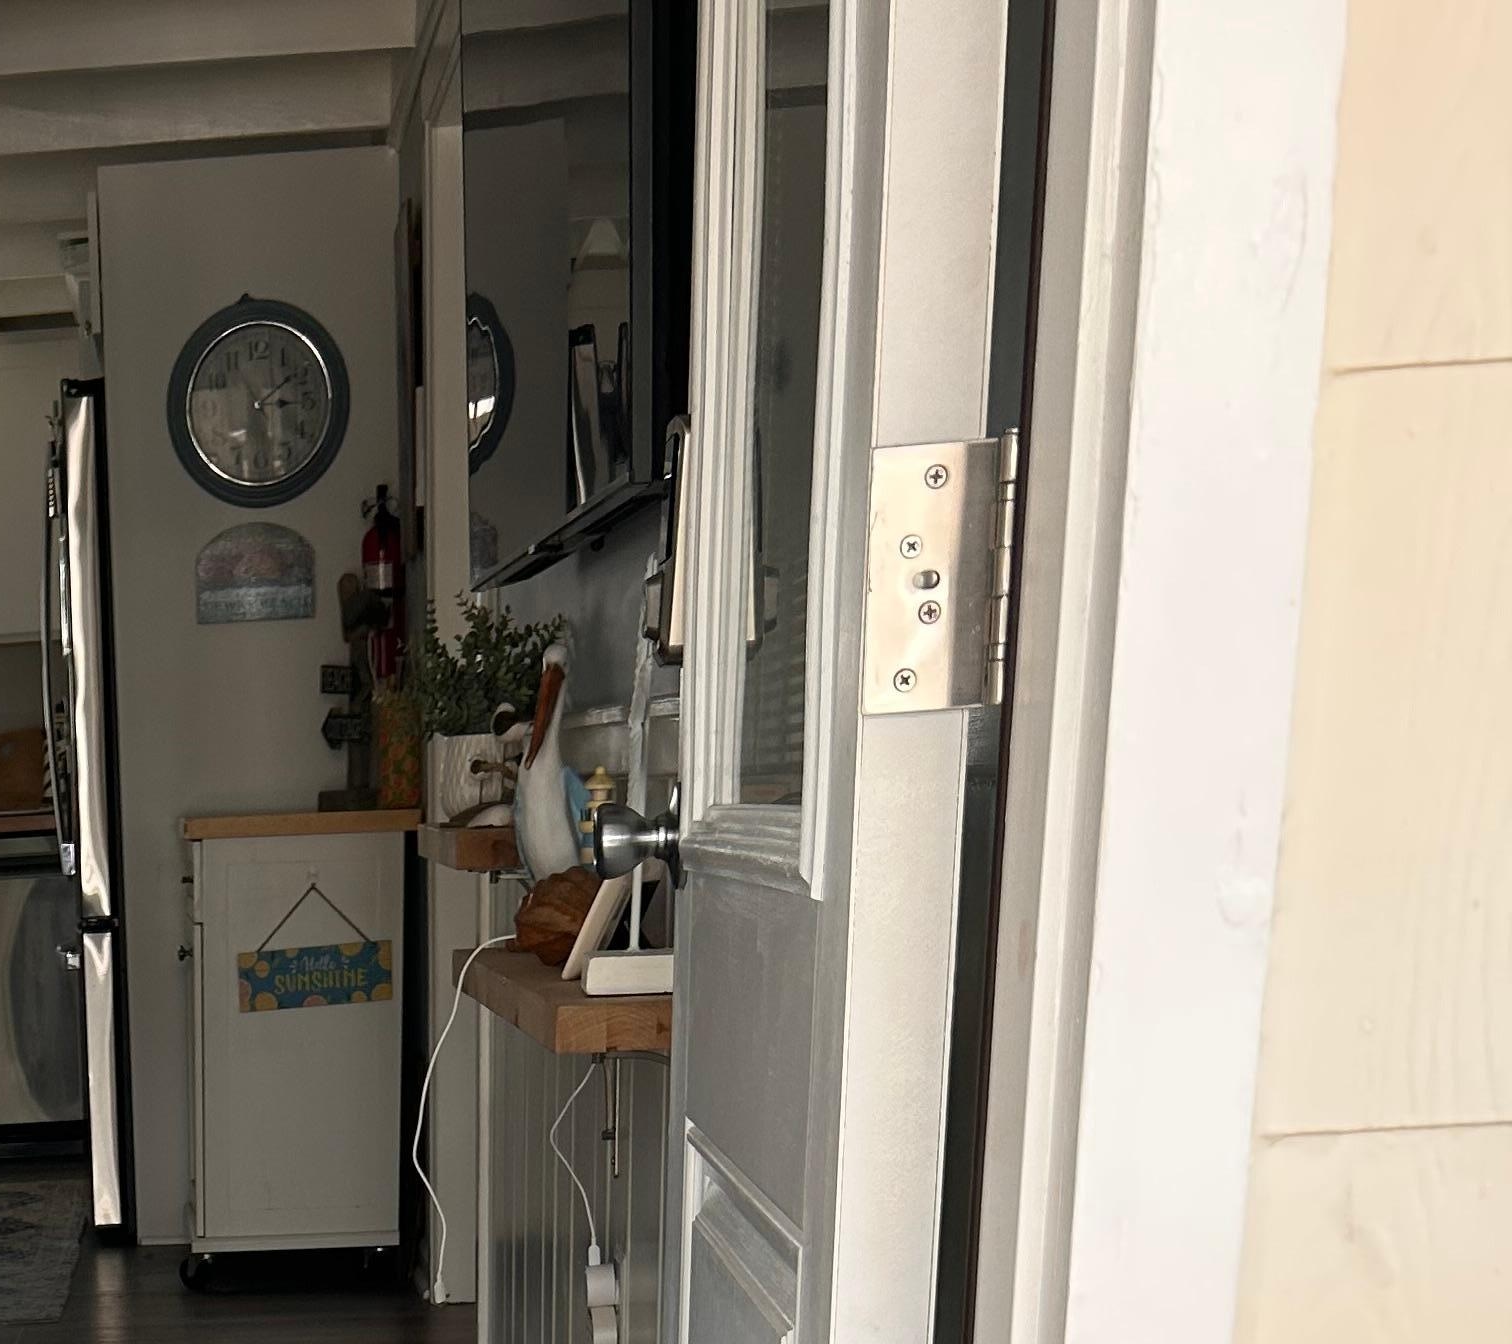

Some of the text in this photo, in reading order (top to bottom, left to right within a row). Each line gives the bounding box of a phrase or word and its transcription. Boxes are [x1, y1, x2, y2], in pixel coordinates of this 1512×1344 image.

[226, 350, 239, 371] 11
[249, 339, 270, 361] 12
[280, 347, 287, 367] 1
[274, 967, 369, 995] SUNSHINE
